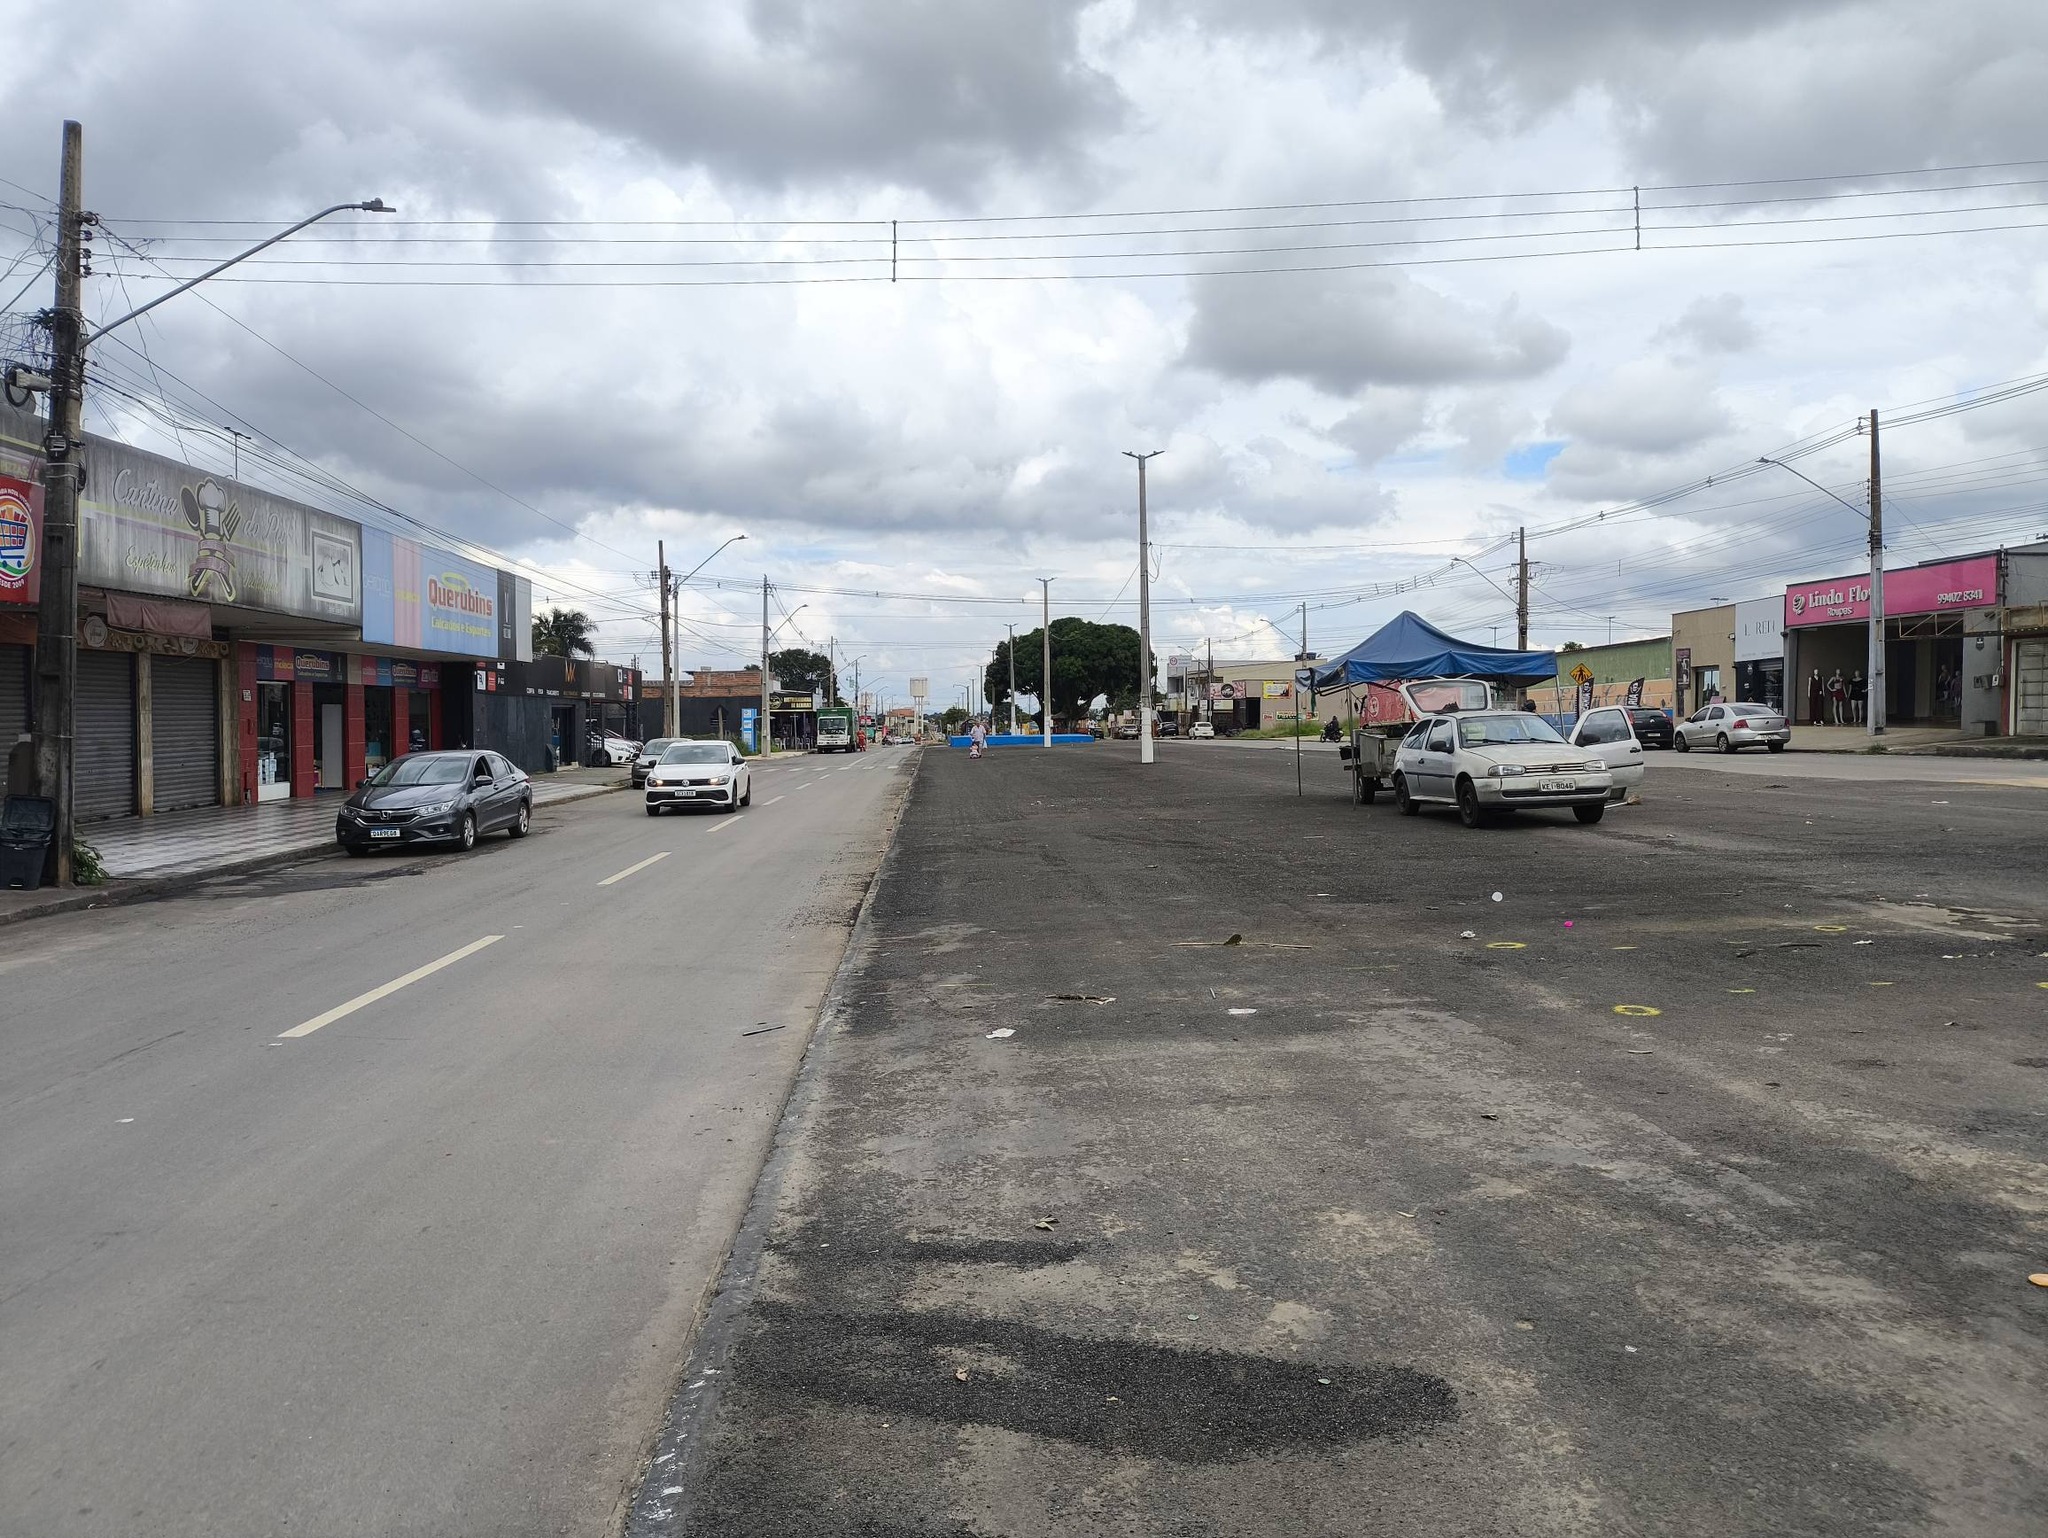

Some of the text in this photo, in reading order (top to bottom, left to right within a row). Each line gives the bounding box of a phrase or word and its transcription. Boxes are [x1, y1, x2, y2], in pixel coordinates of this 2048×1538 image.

[428, 575, 494, 617] Querubins
[1808, 585, 1871, 608] Linda Flo
[1827, 606, 1853, 617] Roupas
[295, 655, 331, 672] Querubins
